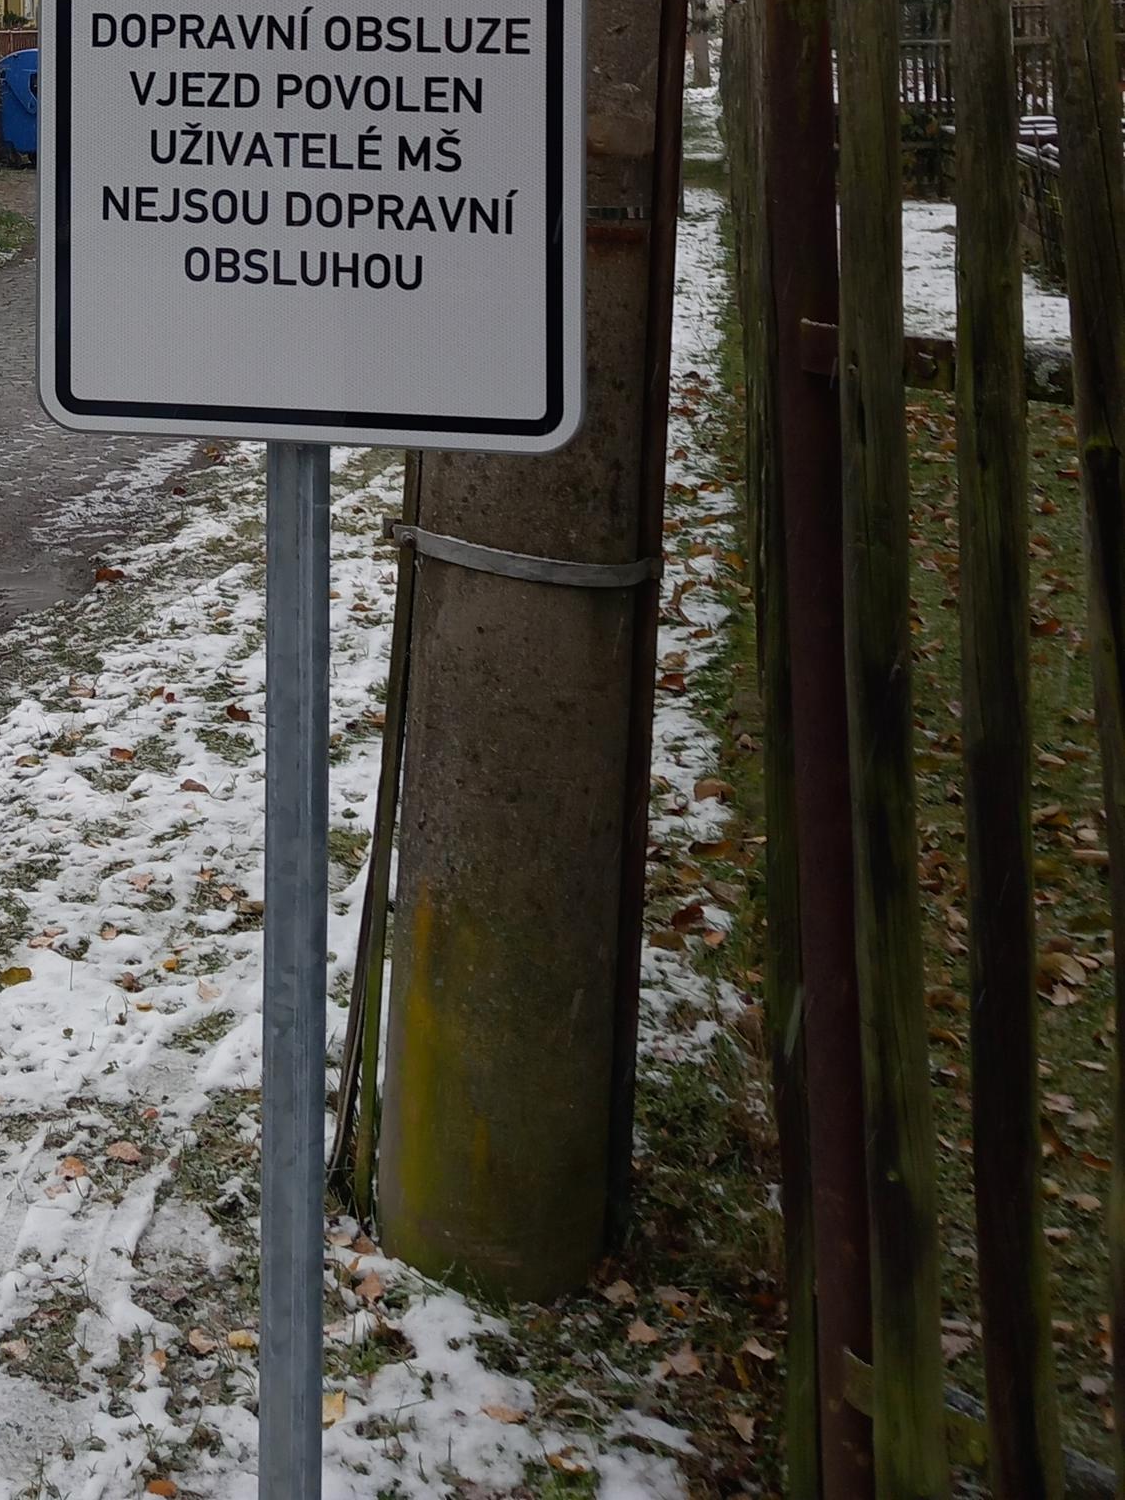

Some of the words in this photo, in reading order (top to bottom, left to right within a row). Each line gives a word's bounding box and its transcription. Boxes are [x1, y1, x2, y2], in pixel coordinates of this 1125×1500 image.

[91, 6, 314, 51] DOPRAVNÍ
[324, 15, 531, 55] OBSLUZE
[129, 70, 261, 109] VJEZD
[276, 73, 483, 114] POVOLEN
[150, 121, 383, 171] UŽIVATELÉ
[398, 128, 462, 173] MŠ
[102, 185, 269, 226] NEJSOU
[285, 189, 519, 235] DOPRAVNÍ
[184, 246, 423, 291] OBSLUHOU
